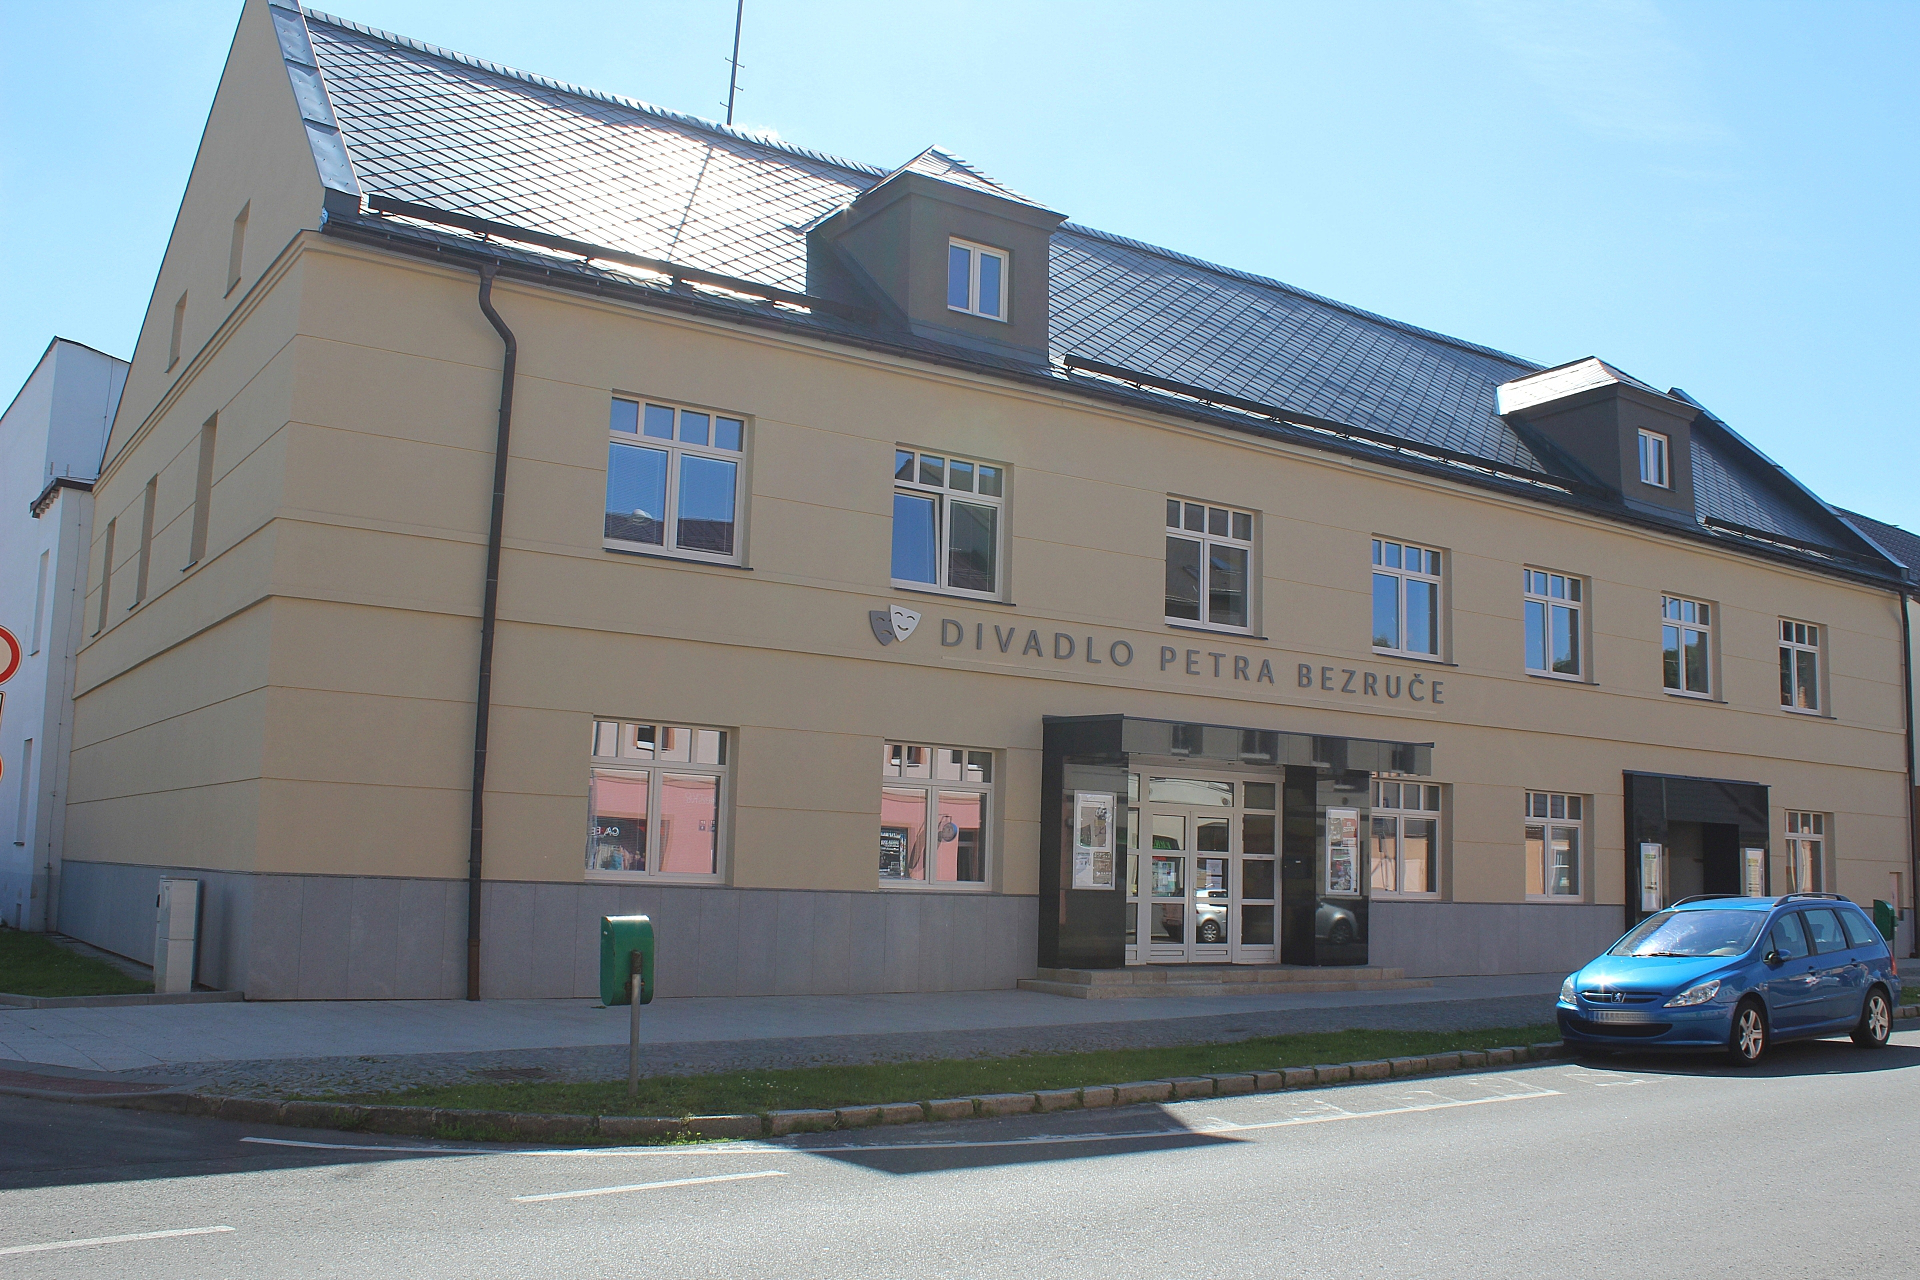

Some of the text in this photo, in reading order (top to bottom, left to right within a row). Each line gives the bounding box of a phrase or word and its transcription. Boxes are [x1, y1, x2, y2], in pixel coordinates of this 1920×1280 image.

[941, 618, 1444, 704] DIVADLO PETRA BEZRUČE
